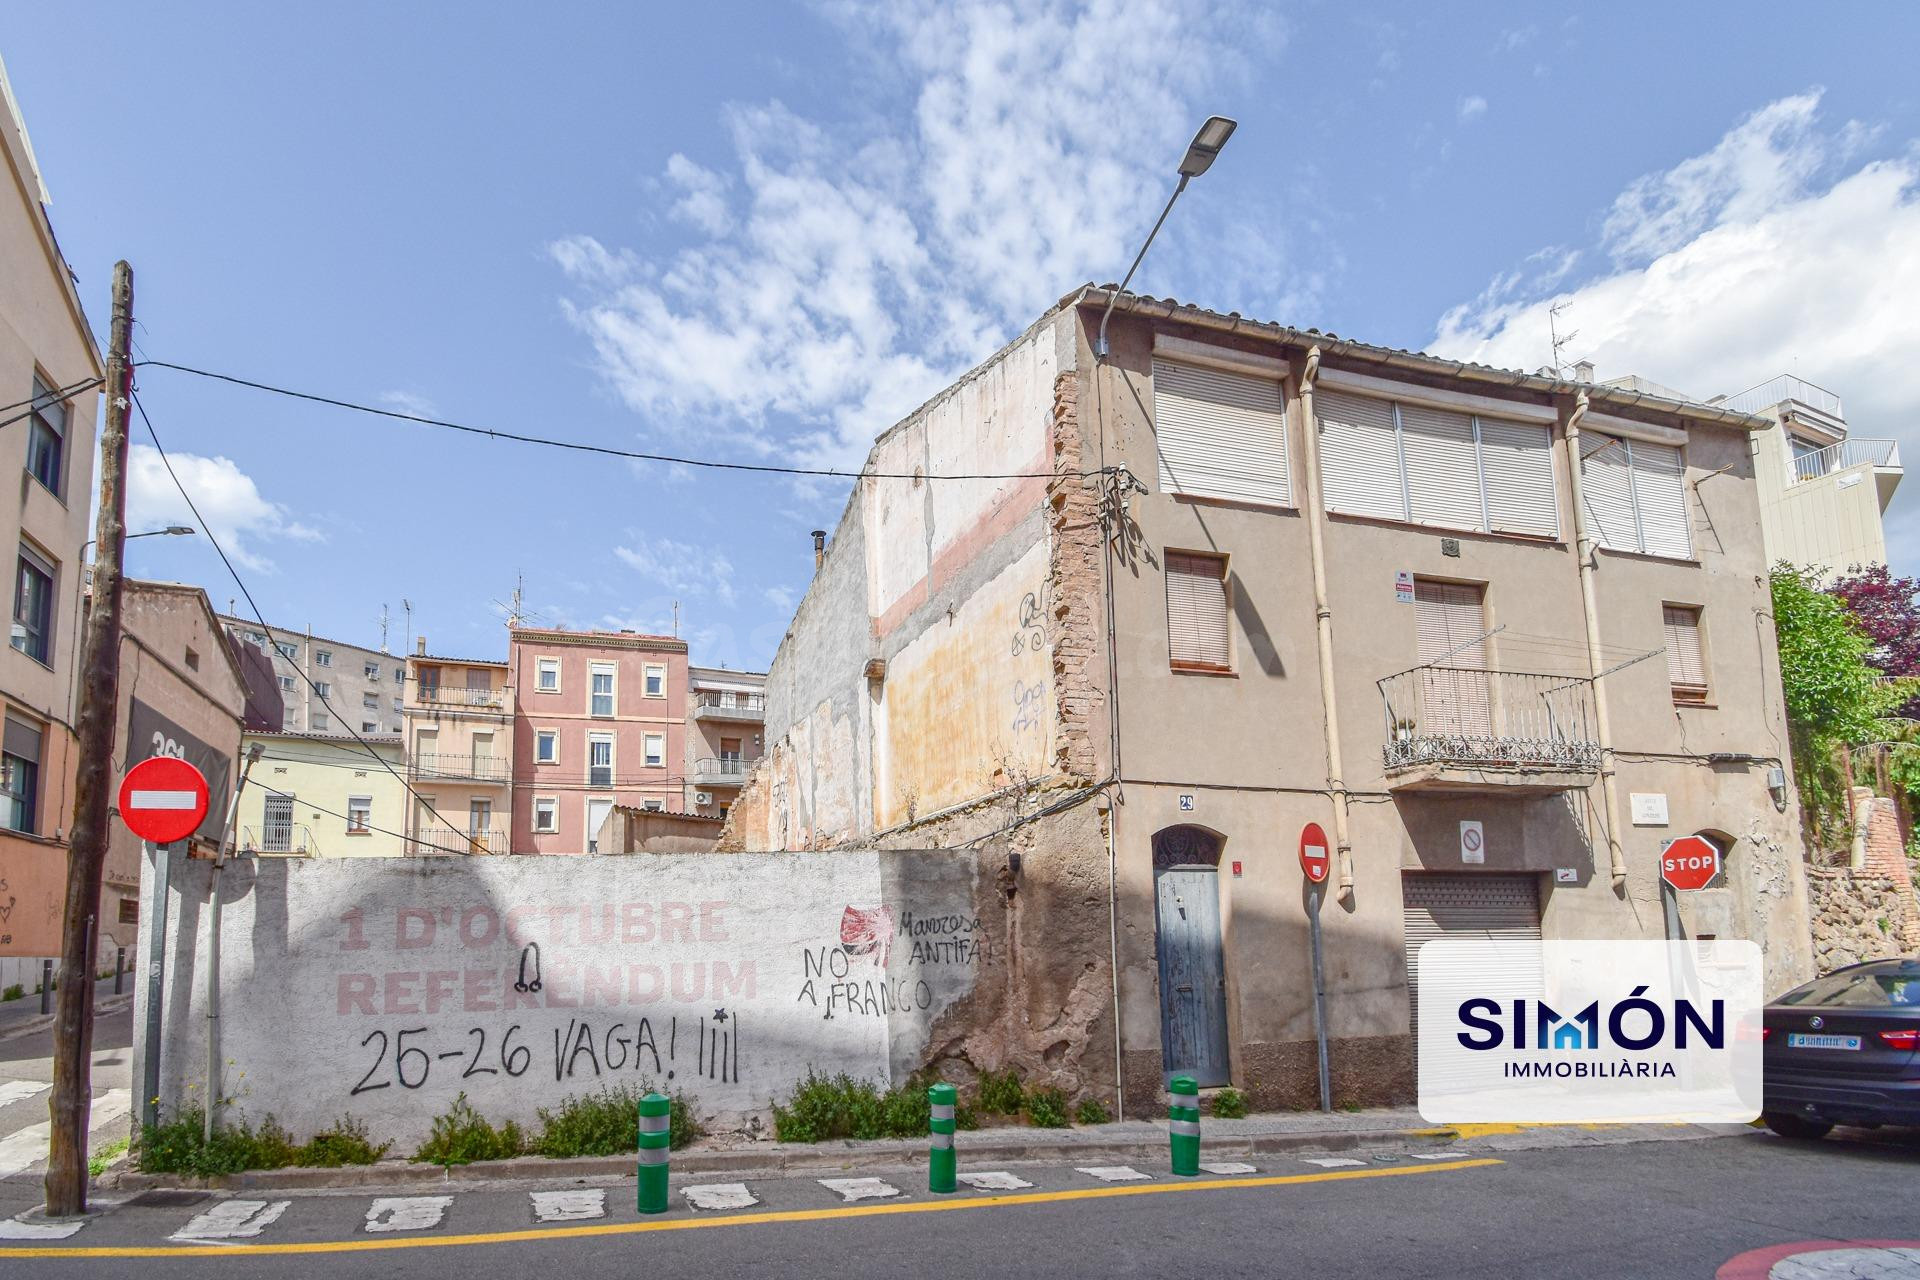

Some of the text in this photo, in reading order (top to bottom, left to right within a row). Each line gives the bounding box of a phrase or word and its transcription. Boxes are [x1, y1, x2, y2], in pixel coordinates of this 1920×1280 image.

[1180, 796, 1193, 810] 29
[1664, 855, 1713, 872] STOP
[338, 900, 731, 951] 1 D'OCTUBRE
[804, 946, 849, 978] NO
[797, 977, 932, 1017] A FRANCO
[554, 1016, 677, 1082] VAGA!
